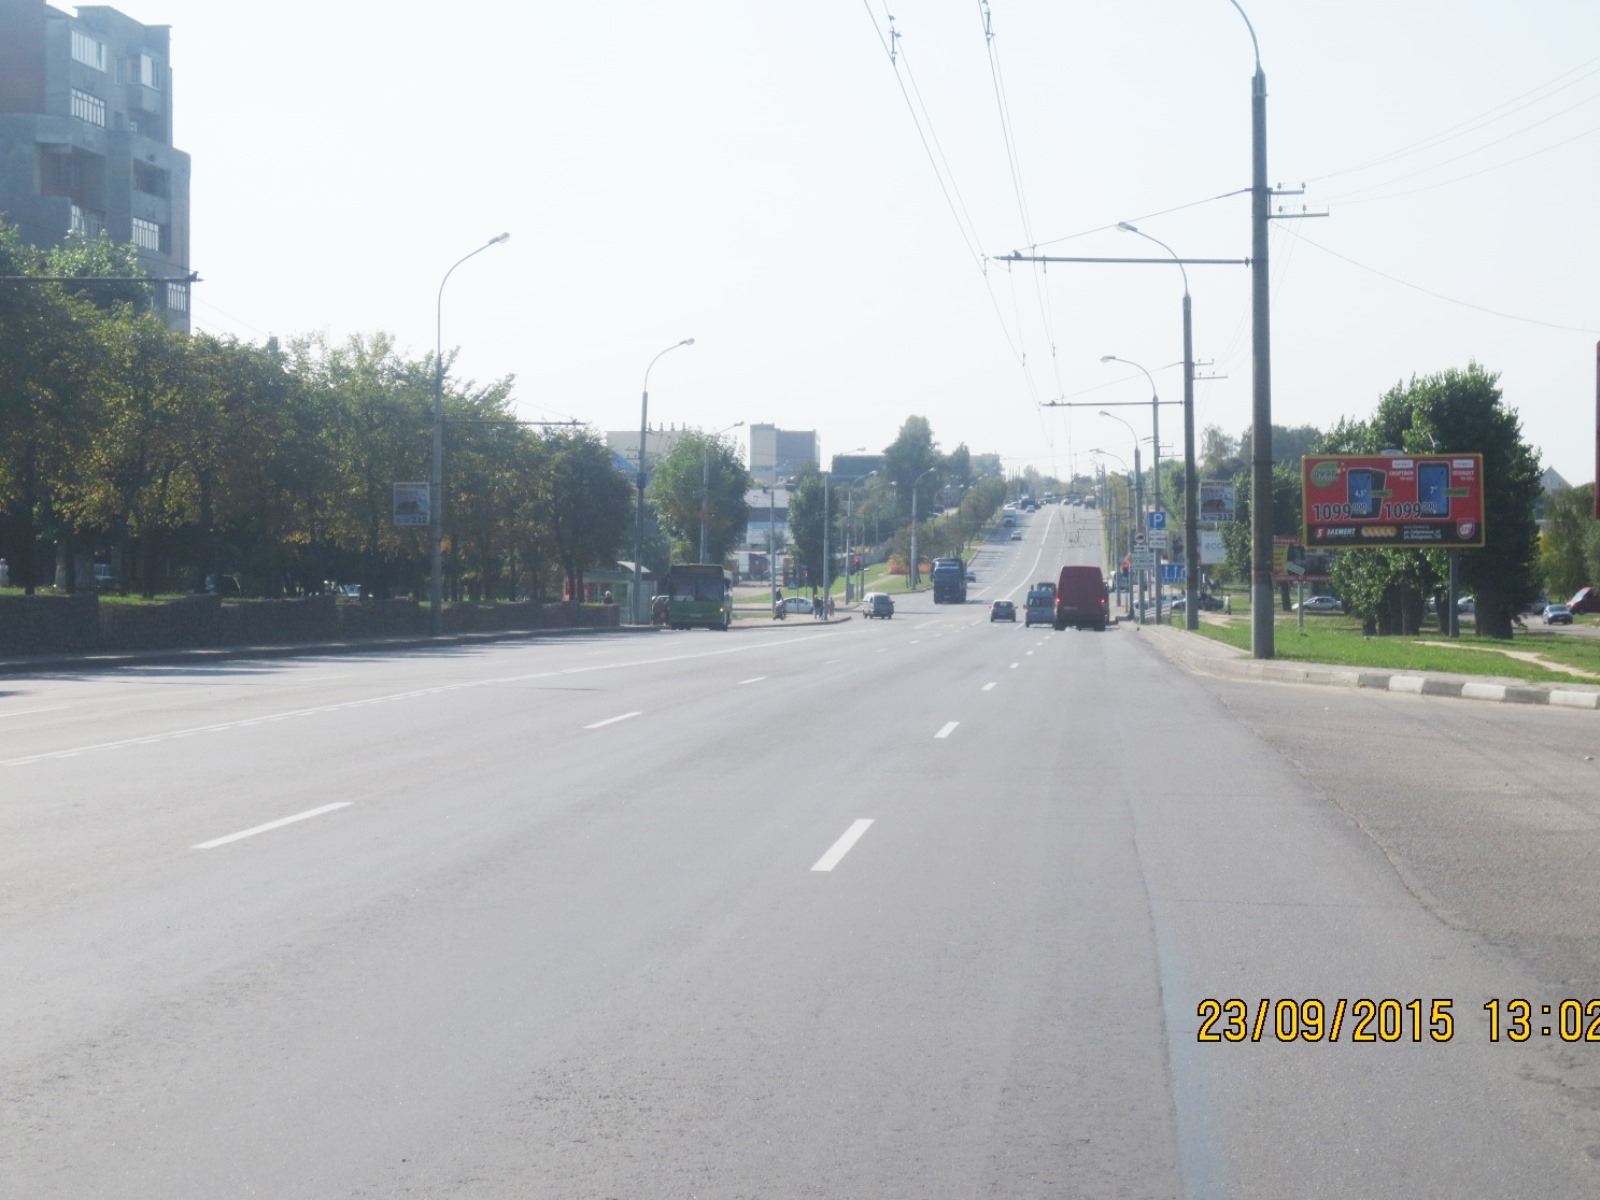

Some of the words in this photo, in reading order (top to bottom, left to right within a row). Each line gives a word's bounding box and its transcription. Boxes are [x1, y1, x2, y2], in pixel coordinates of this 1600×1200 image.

[1313, 503, 1351, 520] 1099
[1385, 502, 1422, 519] 1099
[1153, 513, 1163, 527] P
